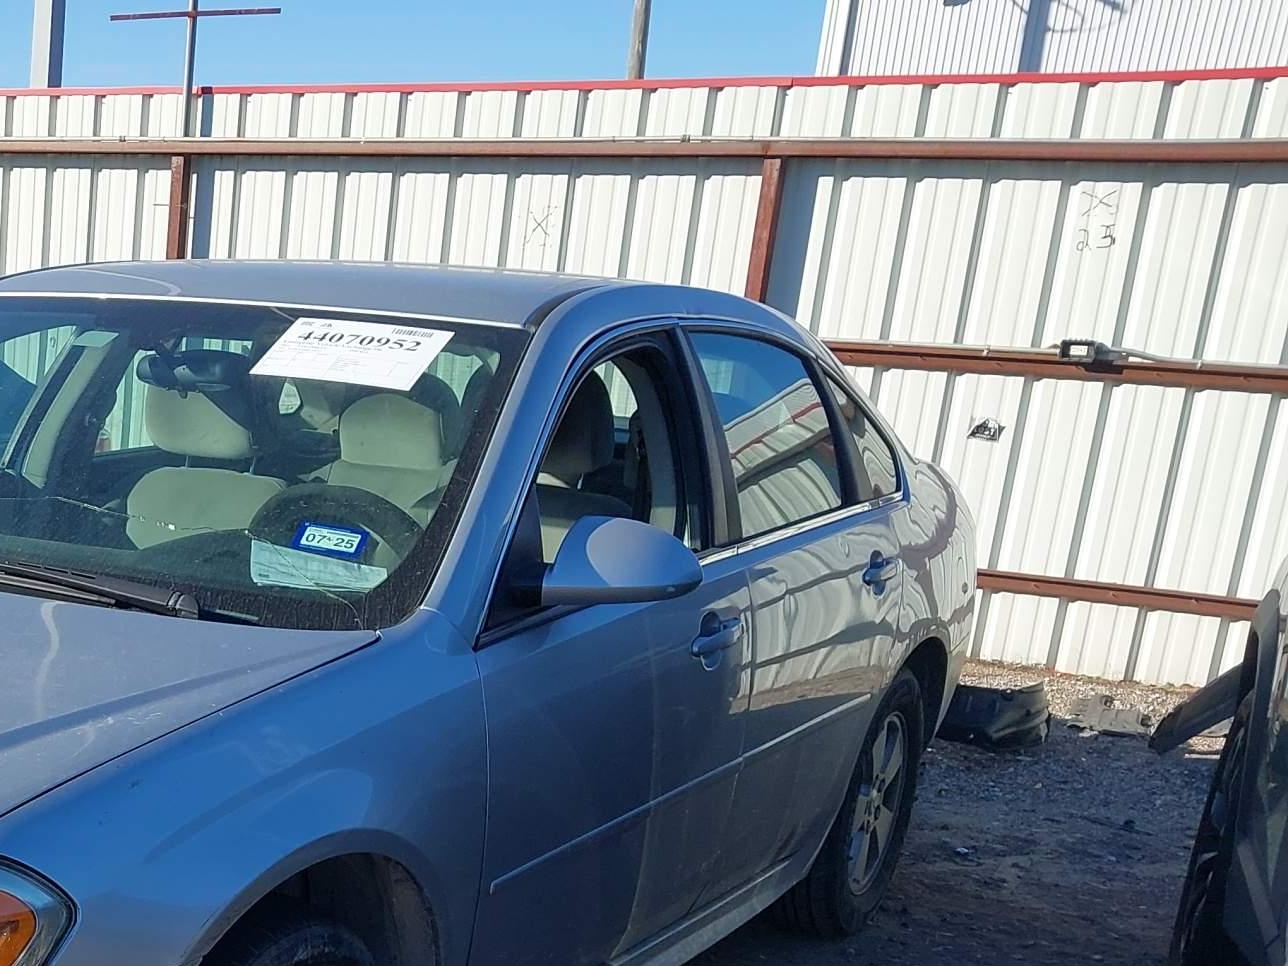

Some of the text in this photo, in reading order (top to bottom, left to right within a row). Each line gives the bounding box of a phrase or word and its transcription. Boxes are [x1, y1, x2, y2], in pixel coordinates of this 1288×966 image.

[297, 329, 422, 352] 44070952
[305, 533, 328, 545] 07
[333, 537, 356, 549] 25
